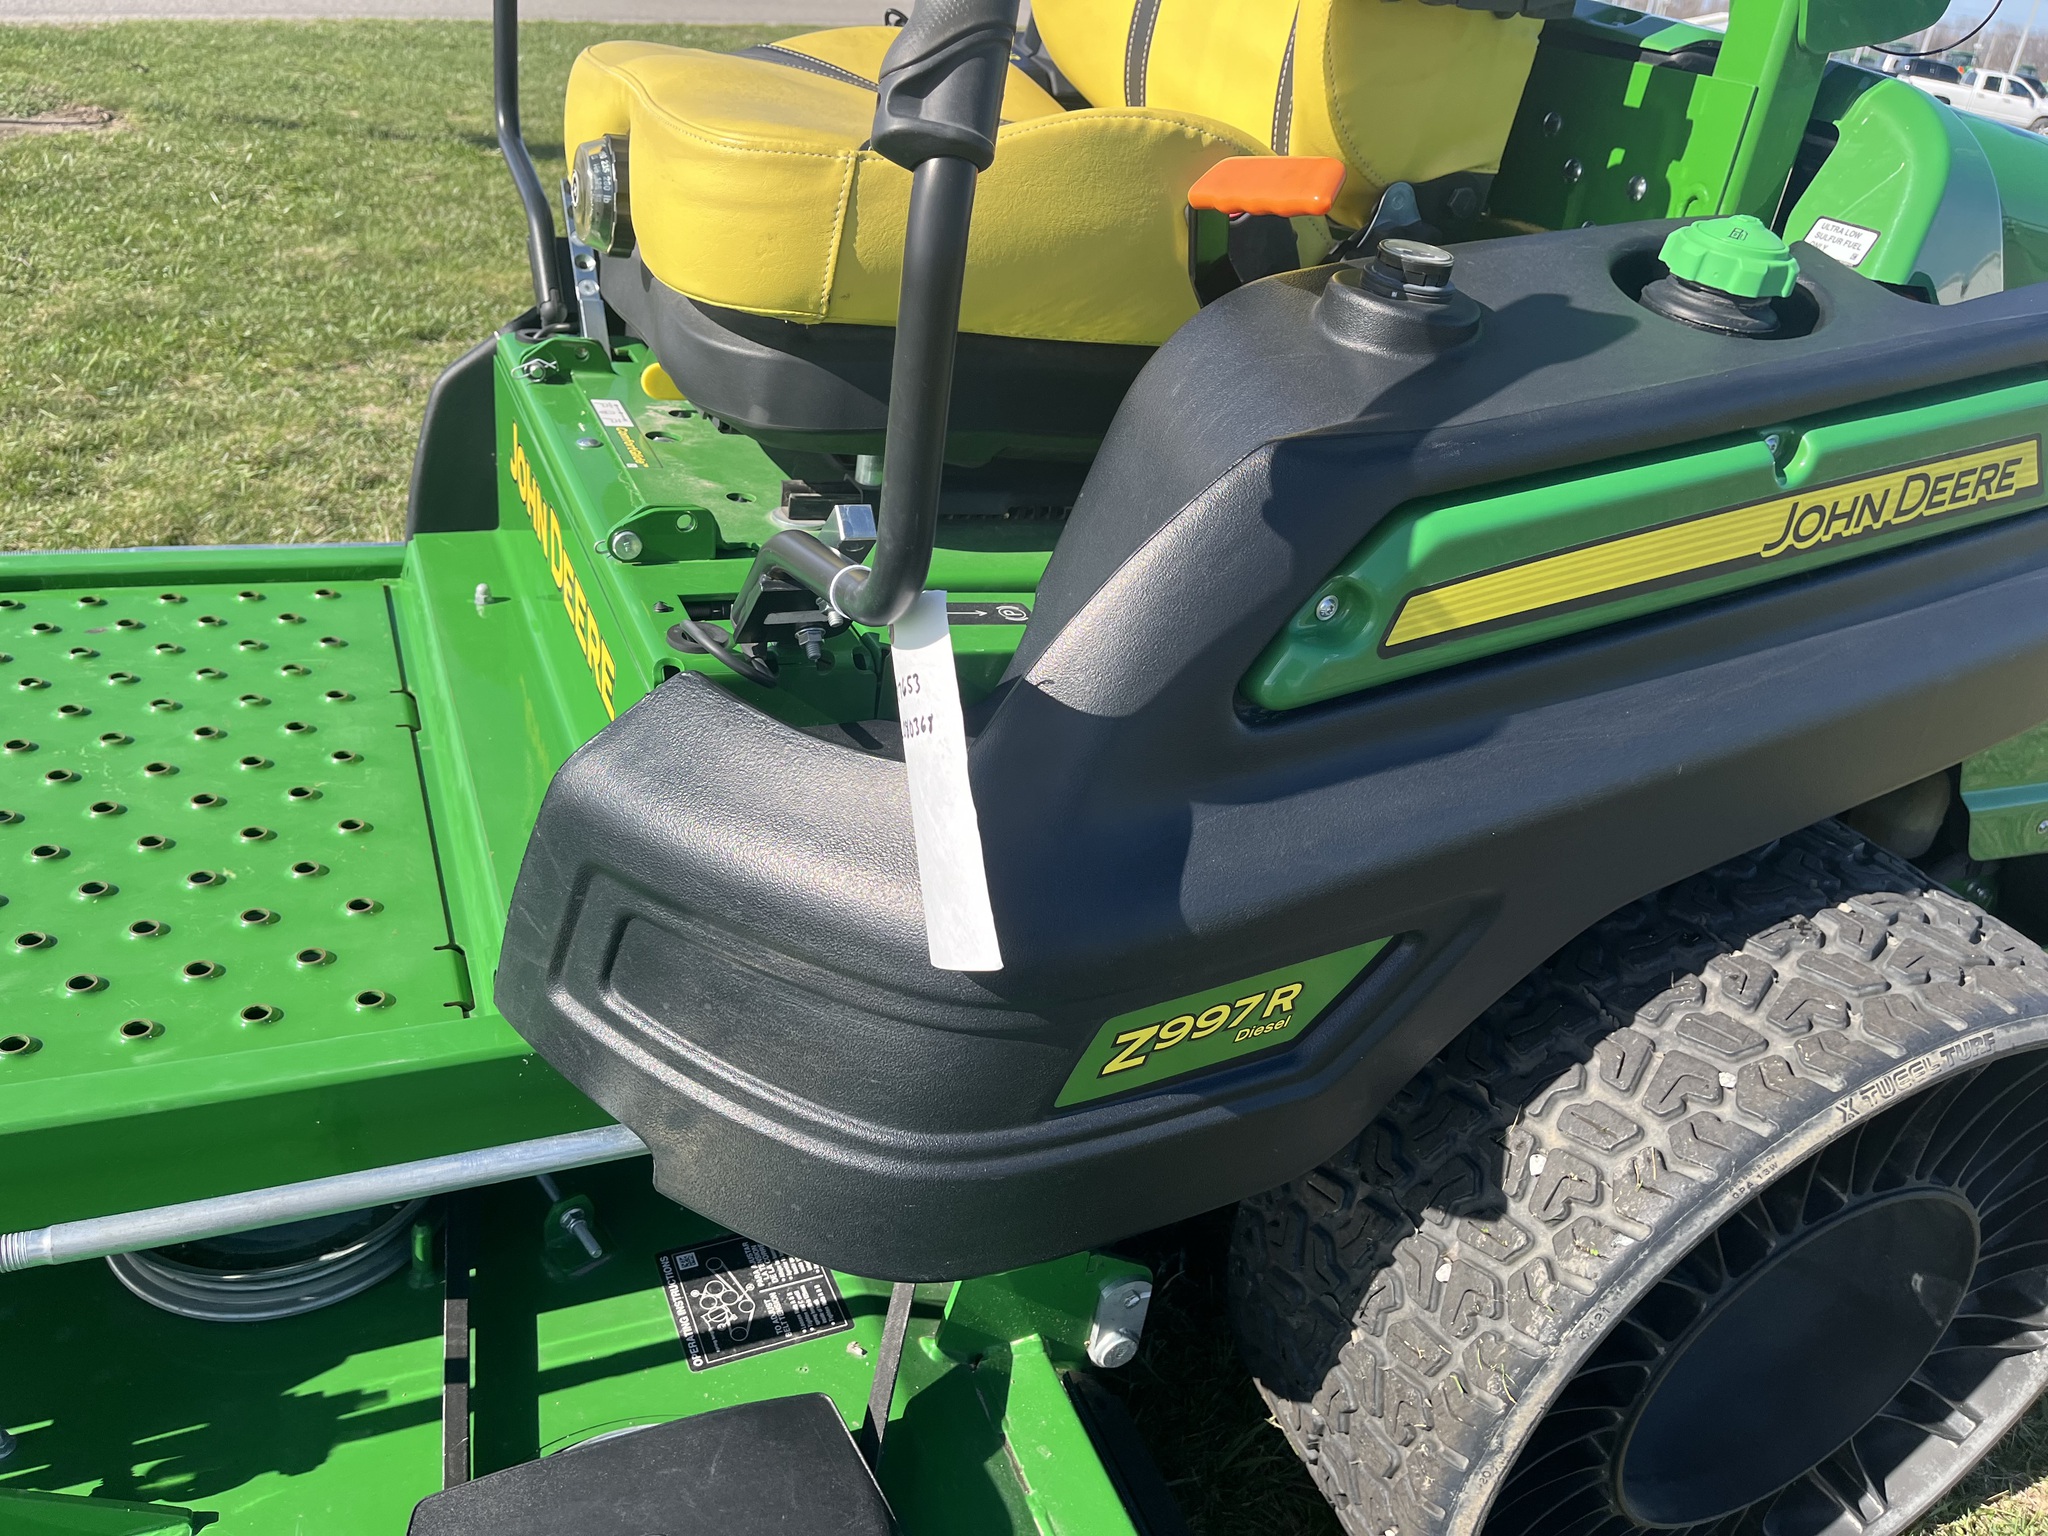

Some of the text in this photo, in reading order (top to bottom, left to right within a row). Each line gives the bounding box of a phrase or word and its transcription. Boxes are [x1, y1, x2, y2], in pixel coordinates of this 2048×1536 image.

[1814, 231, 1862, 251] SULFUR FUEL
[1820, 222, 1864, 240] ULTRA LOW
[1762, 457, 2024, 556] JOHN DEERE
[510, 419, 616, 722] JOHN DEERE
[1097, 981, 1304, 1079] Z997R
[1232, 1014, 1292, 1044] Diesel
[1859, 1056, 1942, 1108] TWEEL
[1939, 1031, 1997, 1067] TURF
[769, 1273, 780, 1284] DE
[660, 1255, 704, 1367] OPERATING INSTRUCTIONS
[763, 1299, 783, 1335] TO ADJUST
[768, 1291, 786, 1321] TENSION
[780, 1320, 793, 1338] BELT
